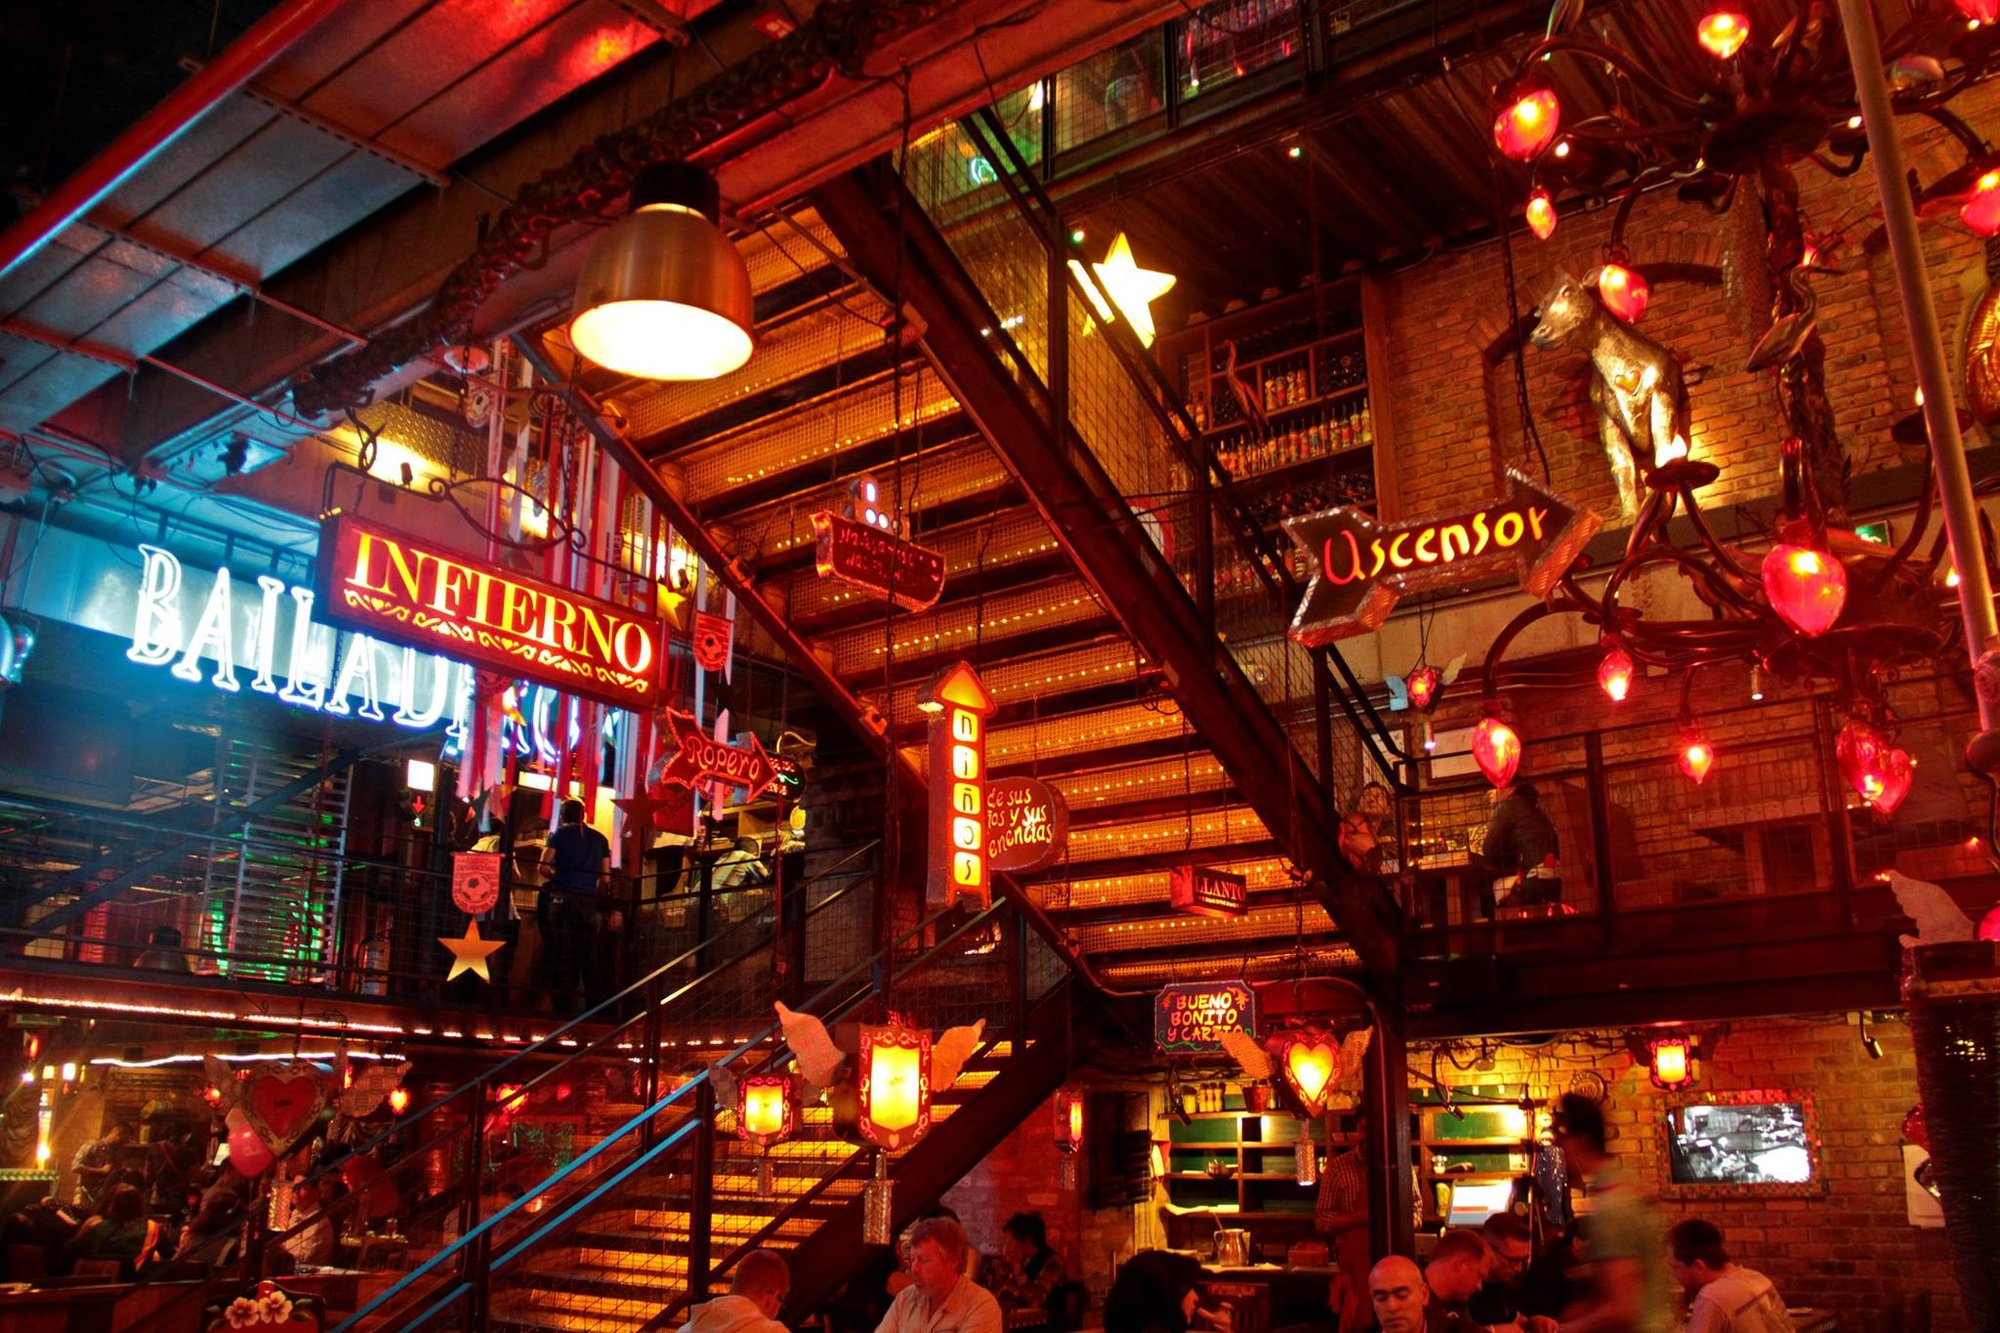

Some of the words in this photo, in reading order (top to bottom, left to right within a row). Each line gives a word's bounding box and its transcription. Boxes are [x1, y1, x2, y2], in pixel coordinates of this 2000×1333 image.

[345, 527, 653, 674] INFIERNO
[685, 735, 760, 780] Ropero
[986, 787, 1004, 808] de
[1007, 788, 1032, 807] sus
[1009, 806, 1020, 827] y
[1021, 804, 1047, 826] sus
[1195, 875, 1246, 901] LLANTO
[1176, 992, 1232, 1010] BUENO
[1171, 1008, 1238, 1026] BONITO
